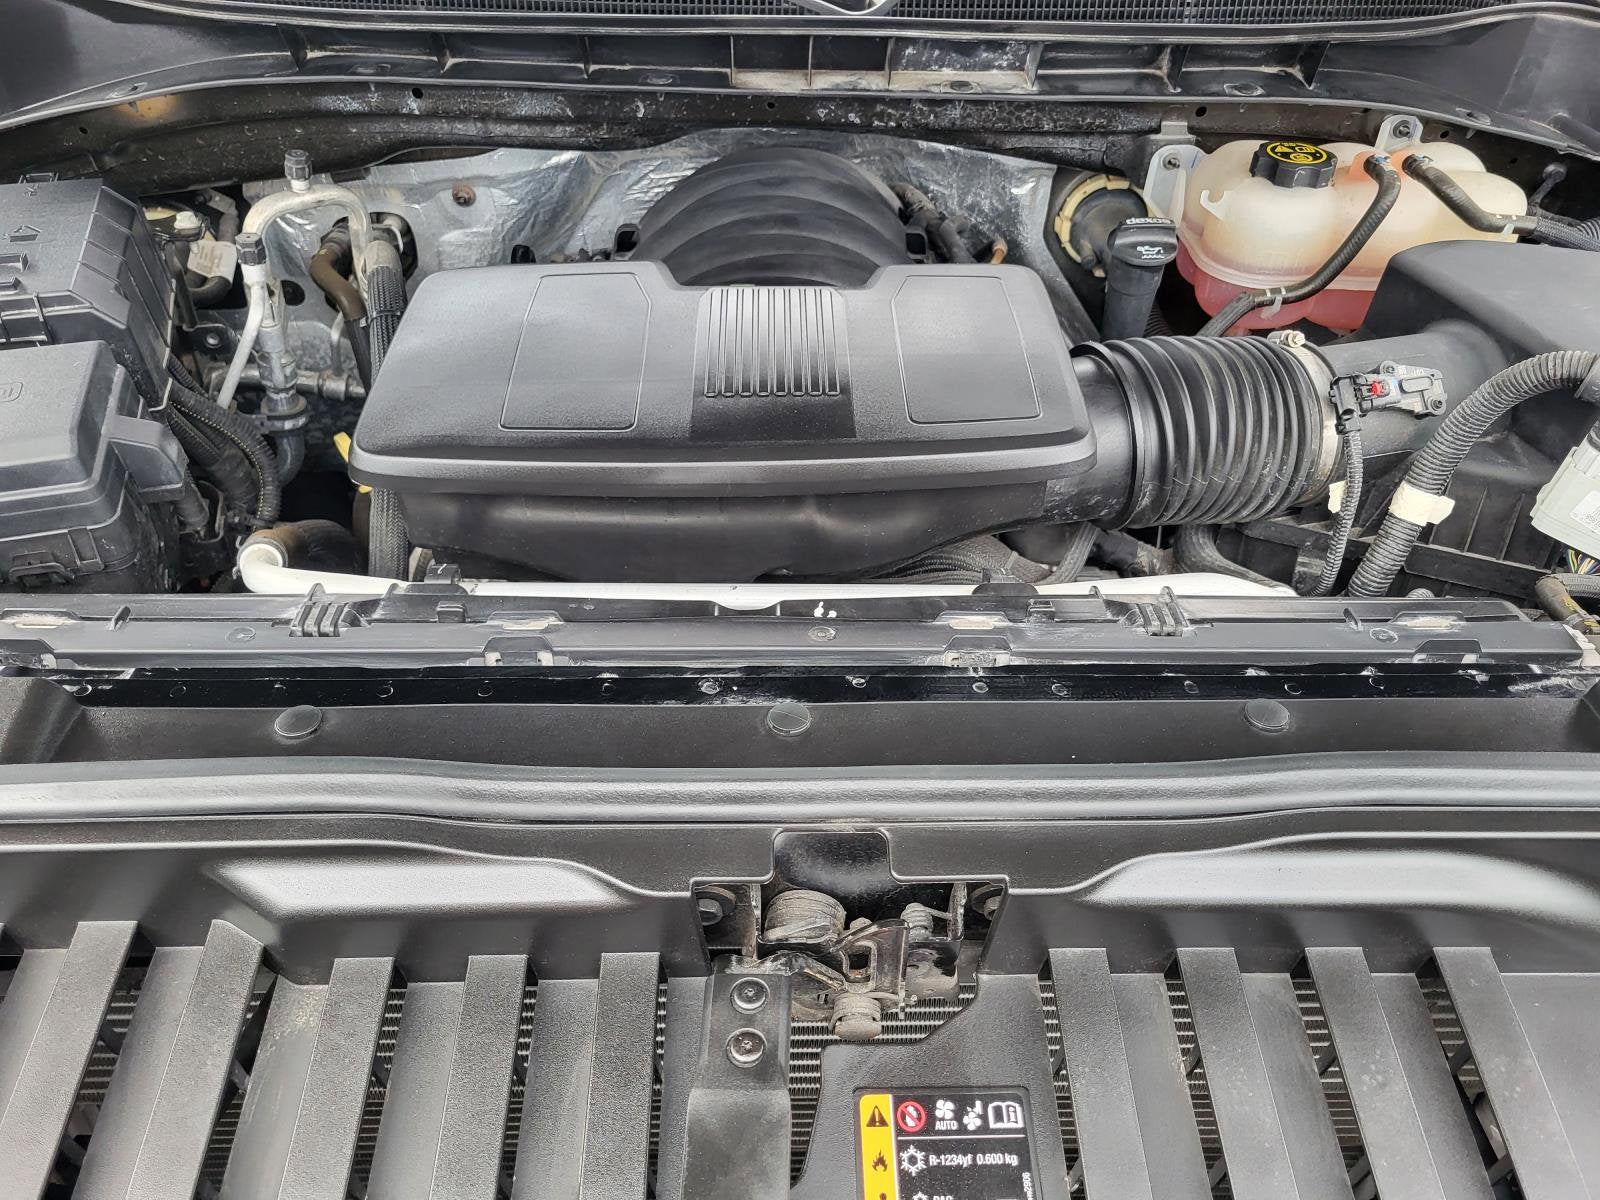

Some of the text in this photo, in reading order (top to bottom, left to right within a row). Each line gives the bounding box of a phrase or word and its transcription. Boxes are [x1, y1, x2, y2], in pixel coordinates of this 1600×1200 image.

[935, 1121, 957, 1130] AUTO
[929, 1153, 1018, 1167] R-1234yf 0.600 kg
